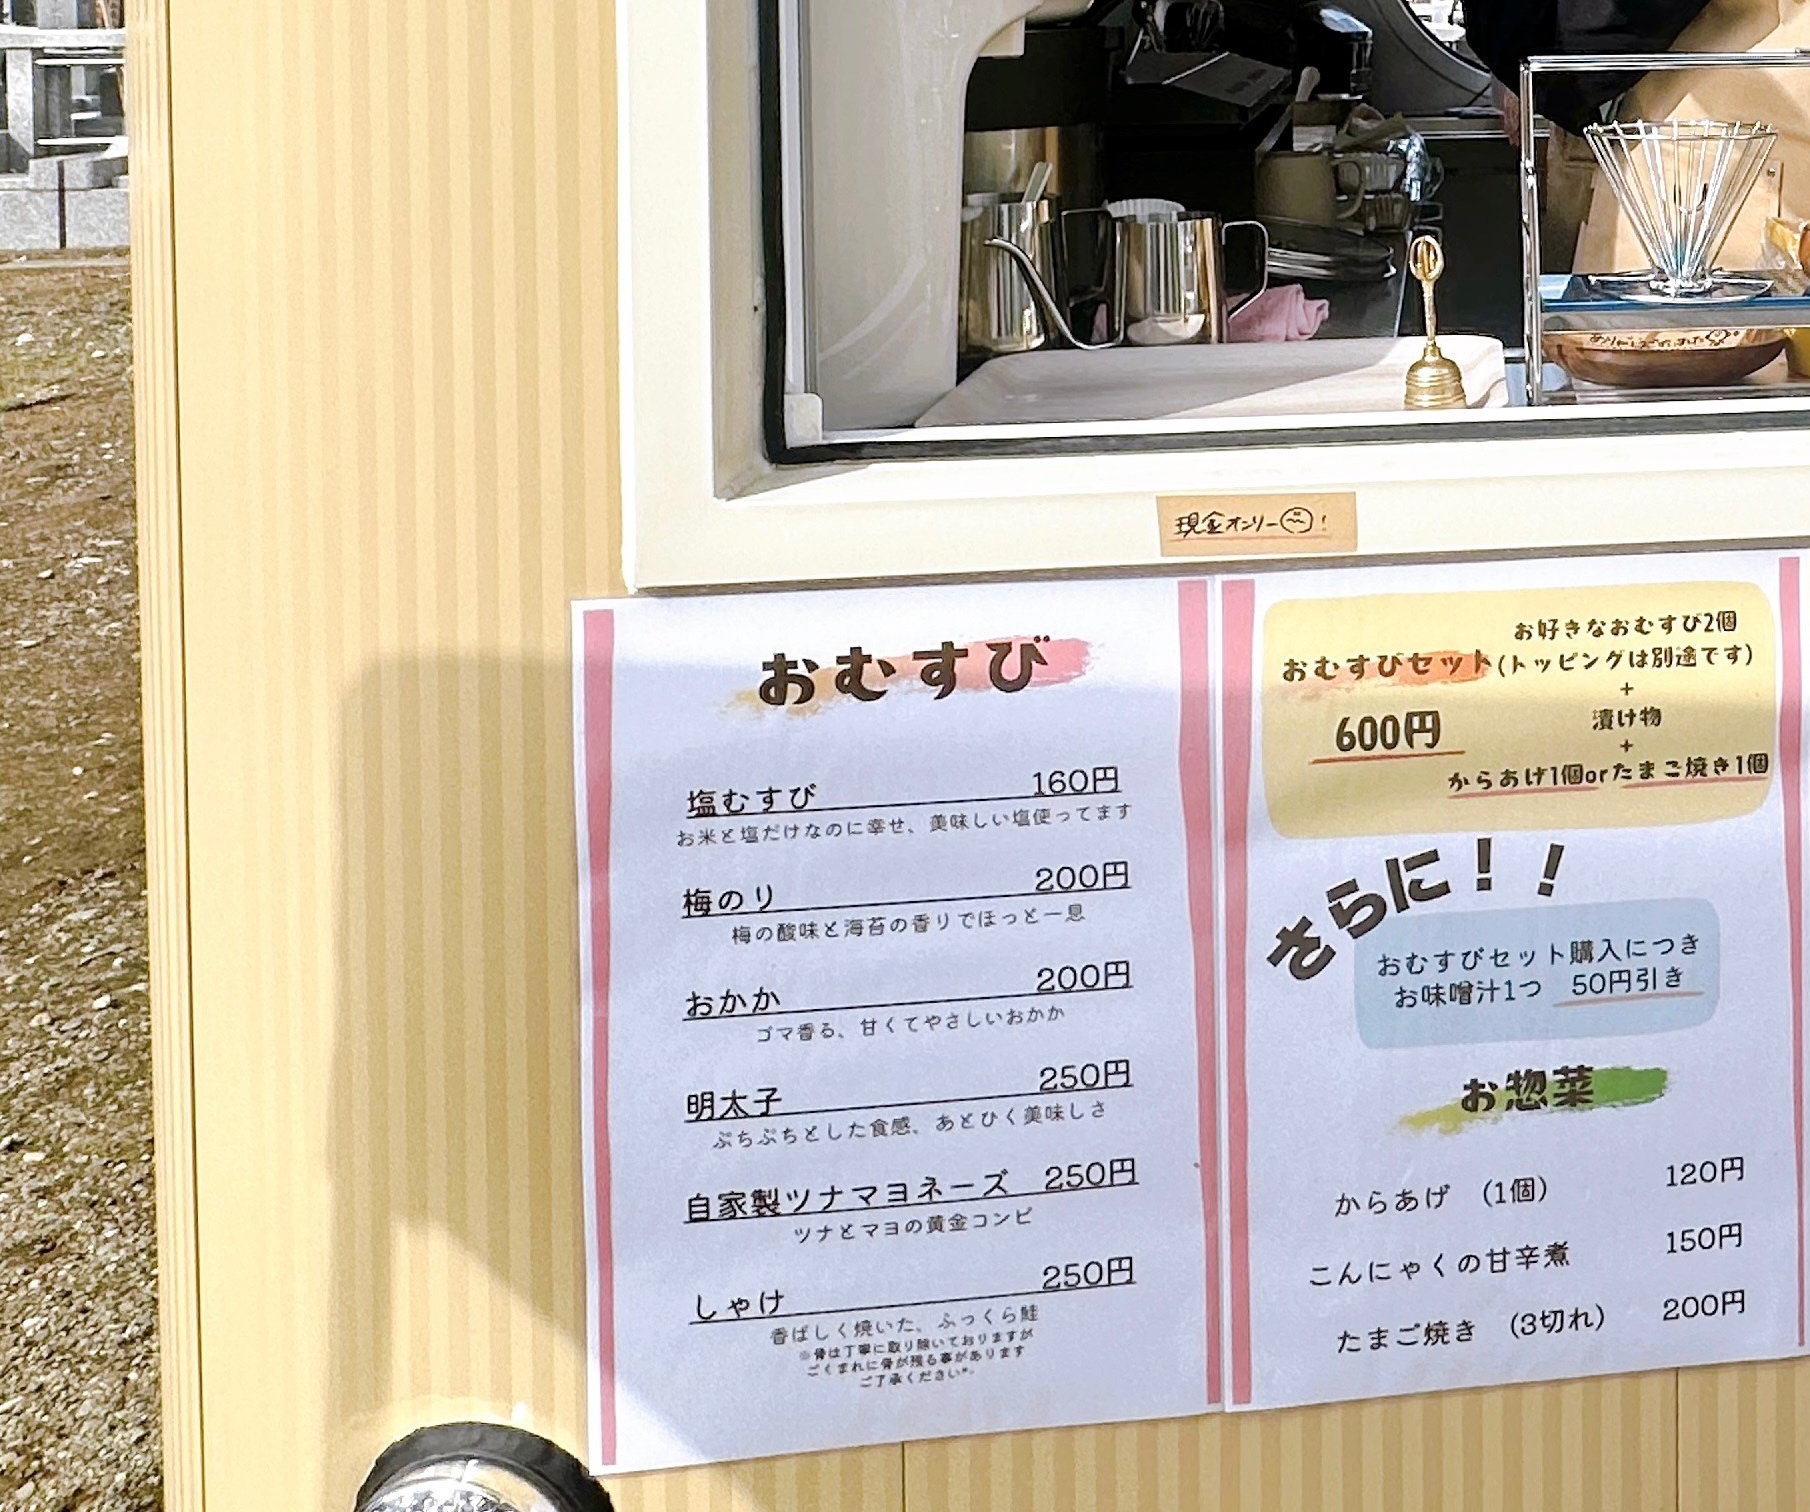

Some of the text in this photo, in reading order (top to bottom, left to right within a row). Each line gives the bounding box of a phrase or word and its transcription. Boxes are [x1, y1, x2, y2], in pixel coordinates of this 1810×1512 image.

[1513, 610, 1738, 641] お好きなおむすび2個
[758, 634, 1050, 706] おむすび
[1281, 642, 1754, 682] おむすびセット (トッピングは別途です)
[1335, 710, 1441, 752] 600円
[1592, 706, 1663, 731] 漬け物
[686, 766, 1121, 818] 塩むすび 160円
[677, 802, 1133, 848] お米と塩だけなのに幸せ、美味しい塩使ってます
[682, 861, 1131, 916] 梅のり 200円
[731, 903, 1087, 946] 梅の酸味と海苔の香りでほっと一息
[1377, 932, 1701, 978] おむすびセット購入につき
[685, 960, 1131, 1017] おかか 200円
[1393, 967, 1685, 1009] お味噌汁1つ 50円引き
[756, 1004, 1066, 1045] ゴマ香る、甘くてやさしいおかか
[686, 1059, 1132, 1120] 明太子 250円
[1460, 1064, 1595, 1113] お惣菜
[686, 1158, 1137, 1221] 自家製ツナマヨネーズ 250円
[1665, 1156, 1745, 1187] 120円
[1334, 1183, 1451, 1217] からあげ
[794, 1207, 1034, 1245] ツナとマヨの黄金コンビ
[1309, 1222, 1744, 1288] こんにゃくの甘辛煮 150円
[695, 1256, 1135, 1321] しゃけ 250円
[1336, 1289, 1747, 1354] たまご焼き (3切れ) 200円
